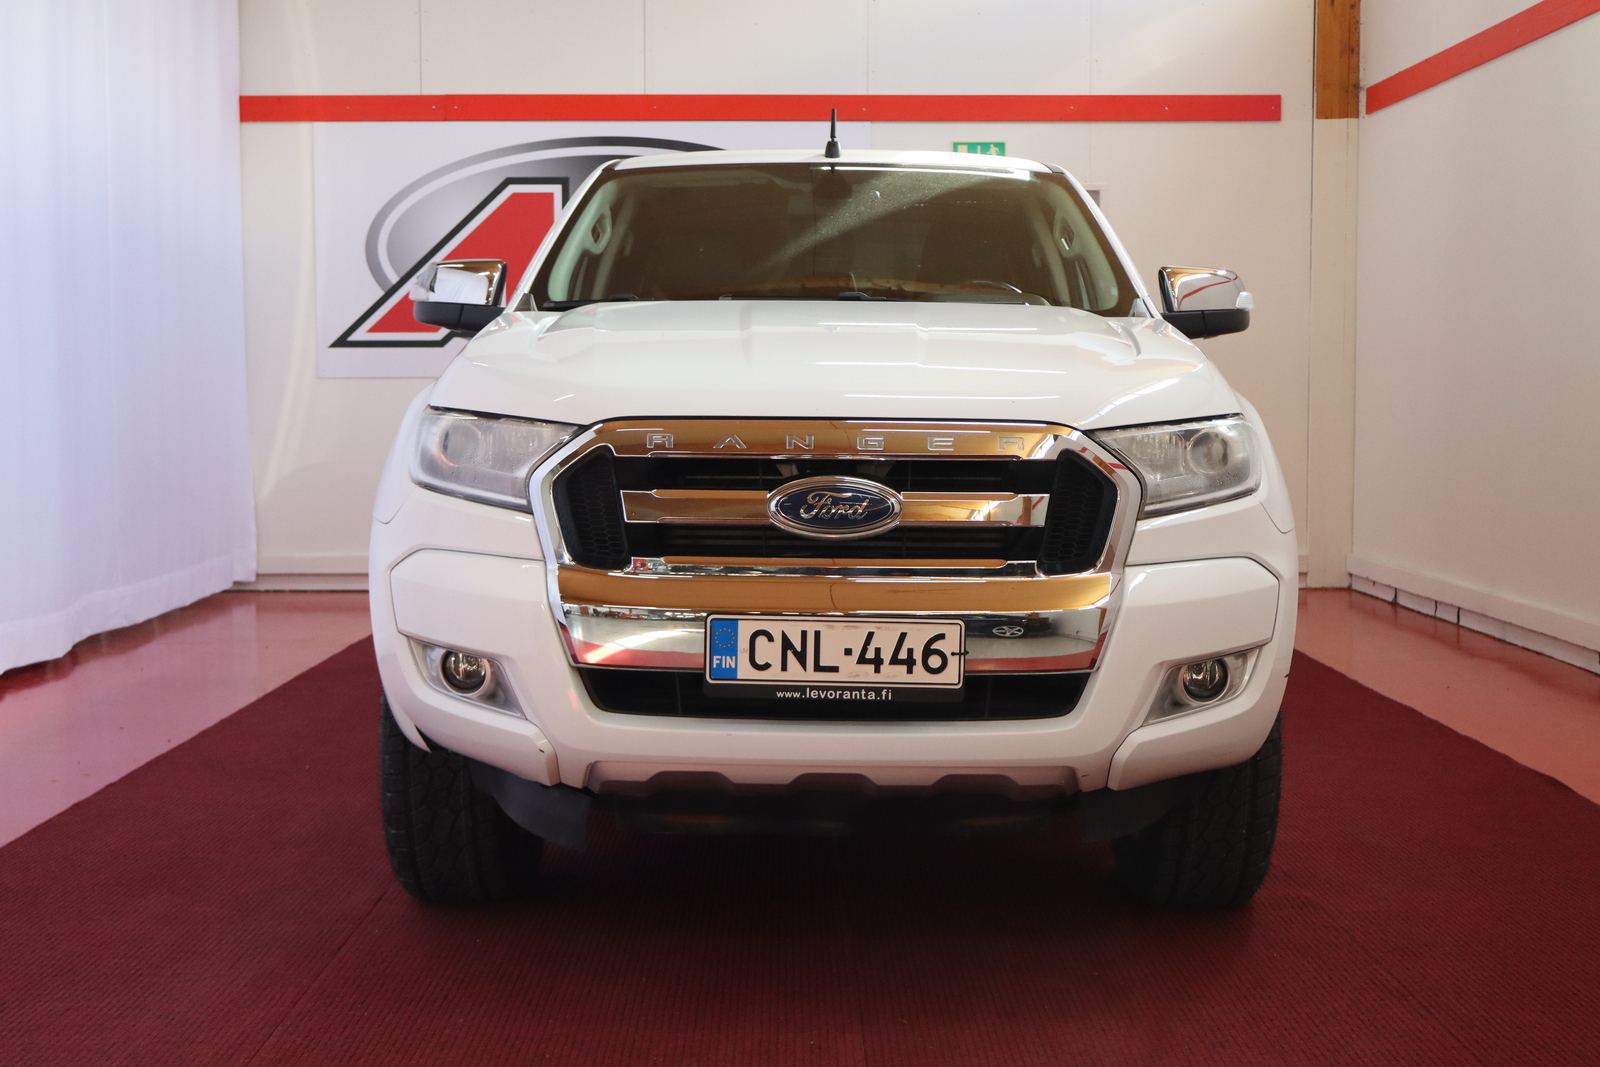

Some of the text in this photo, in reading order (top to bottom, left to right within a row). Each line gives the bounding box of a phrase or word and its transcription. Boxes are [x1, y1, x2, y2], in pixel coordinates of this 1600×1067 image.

[646, 432, 1025, 452] RANGER
[800, 490, 870, 520] Ford
[713, 655, 736, 669] FIN
[776, 687, 892, 701] www.levoranta.fi
